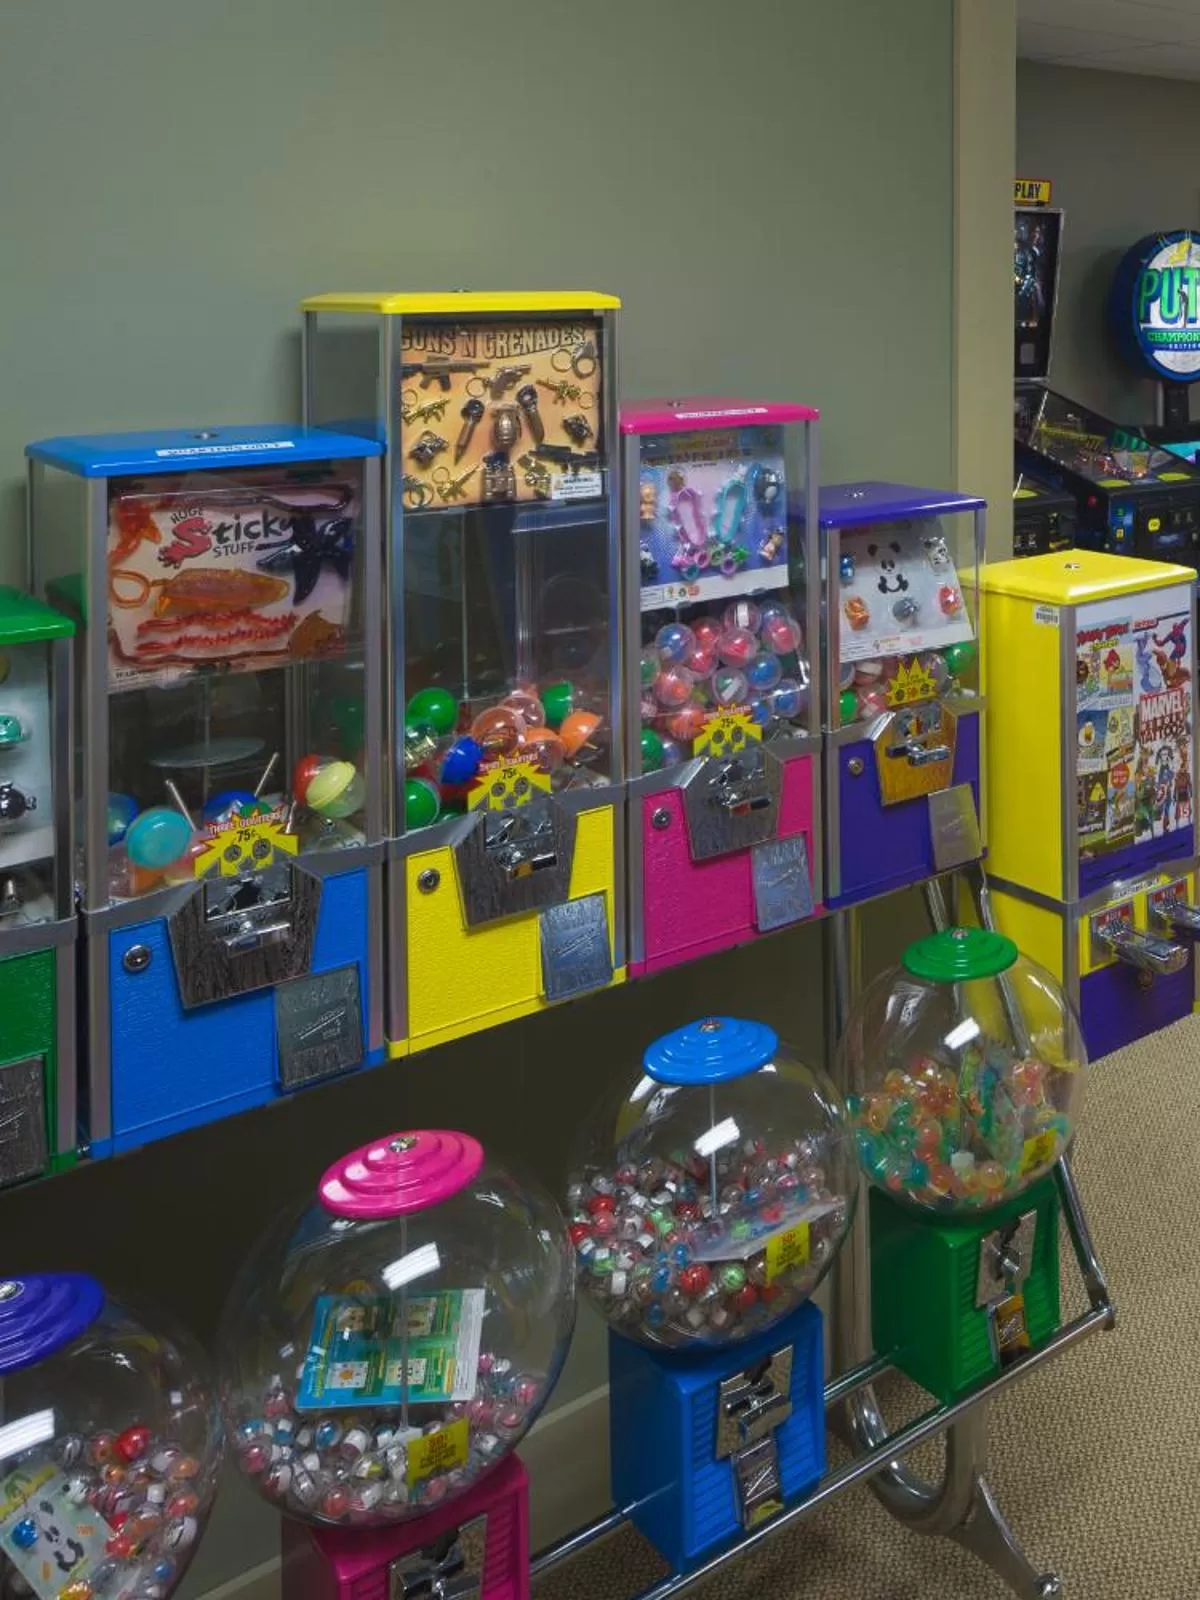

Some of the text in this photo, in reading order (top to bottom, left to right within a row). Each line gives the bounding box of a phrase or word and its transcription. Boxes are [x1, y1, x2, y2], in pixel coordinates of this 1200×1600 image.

[1015, 182, 1040, 200] PLAY
[483, 325, 586, 360] GRENADES
[212, 542, 257, 558] STUFF
[1141, 690, 1183, 718] MARVEL
